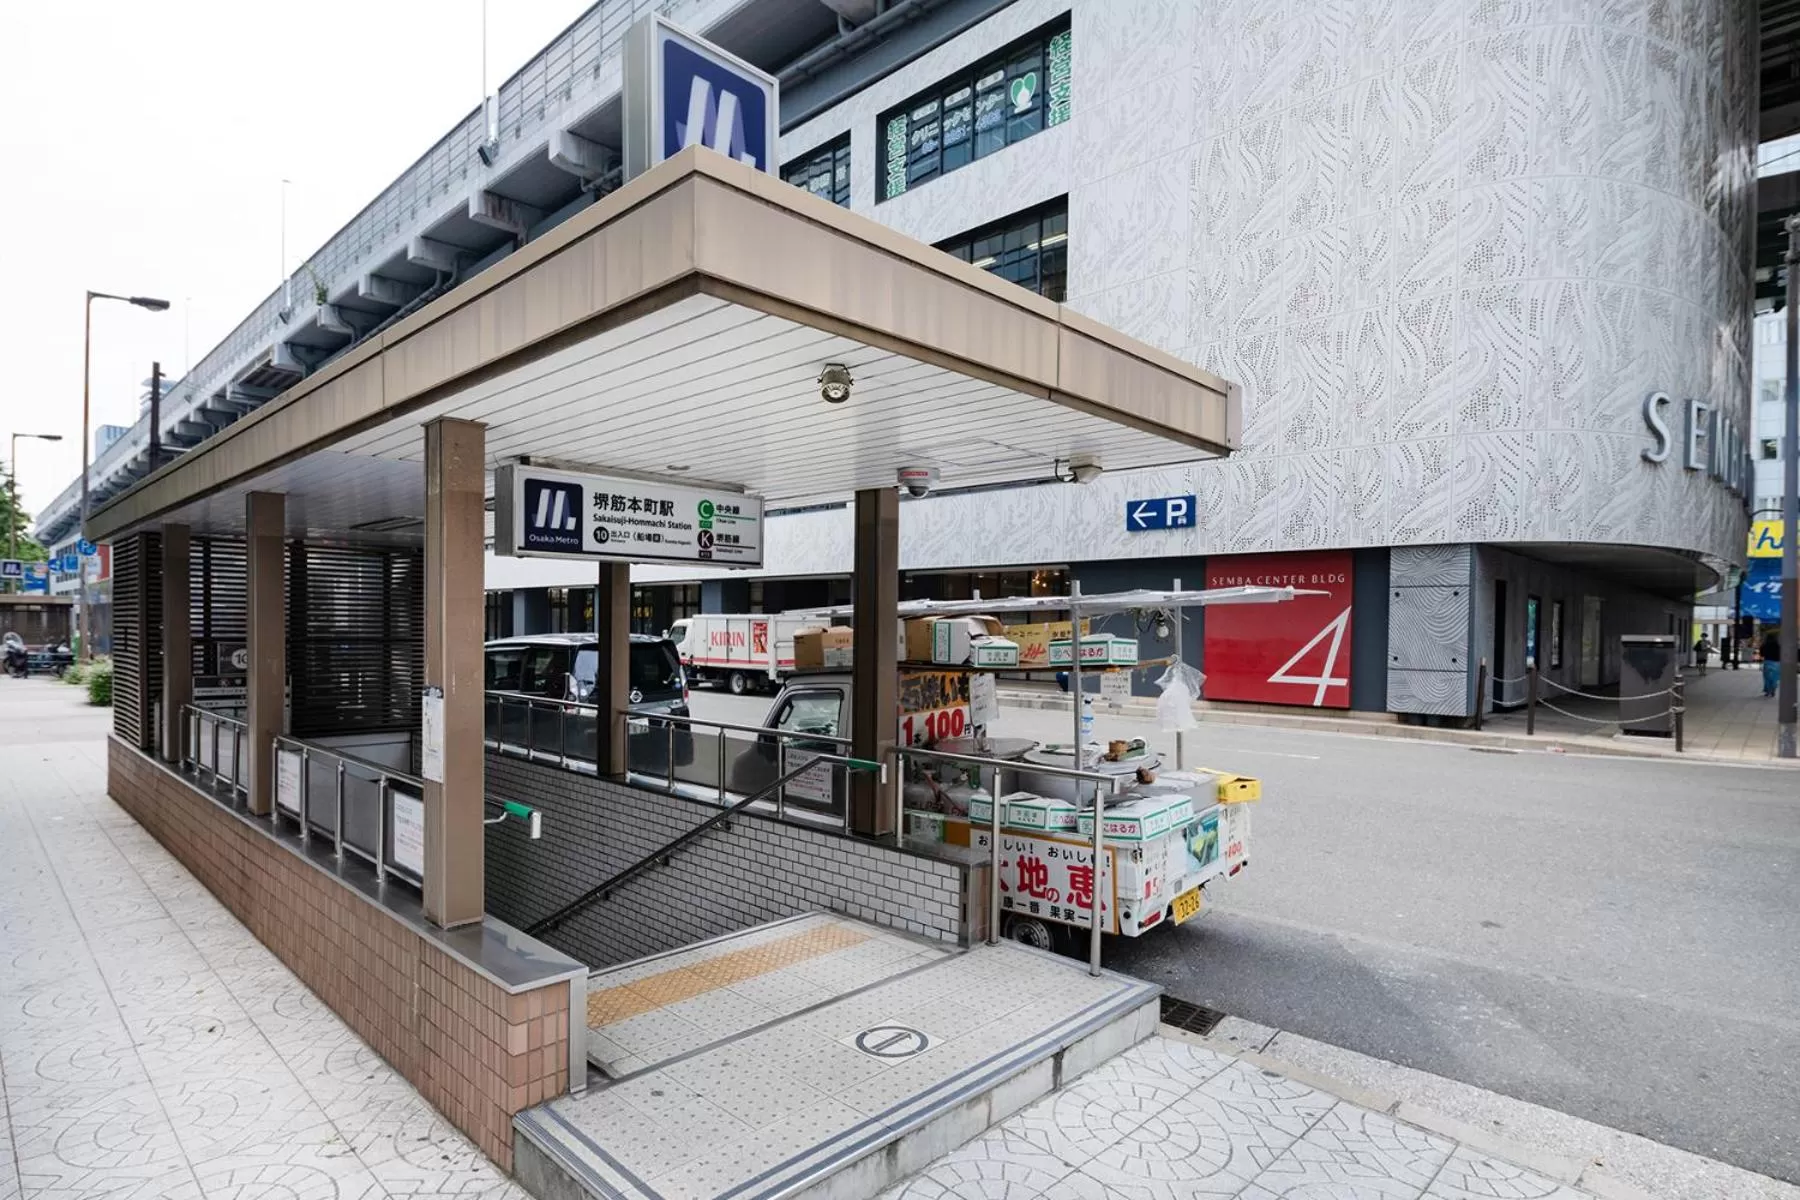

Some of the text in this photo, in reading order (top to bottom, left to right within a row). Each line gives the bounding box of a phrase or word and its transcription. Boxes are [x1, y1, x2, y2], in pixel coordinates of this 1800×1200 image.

[593, 492, 674, 517] 堺筋本町駅
[700, 502, 710, 517] C
[716, 504, 740, 515] 中央線
[1166, 499, 1187, 526] P
[593, 513, 666, 528] Sakaisuji-Hommachi
[667, 520, 692, 530] Station
[529, 534, 579, 544] Osaka Metro
[596, 529, 608, 540] 10
[611, 530, 630, 539] 出入口
[701, 532, 711, 547] K
[1211, 573, 1346, 586] SEMBA CENTER BLDG
[711, 631, 745, 647] KIRIN
[1267, 605, 1352, 706] 4
[978, 835, 1110, 868] おしい！ おいし！
